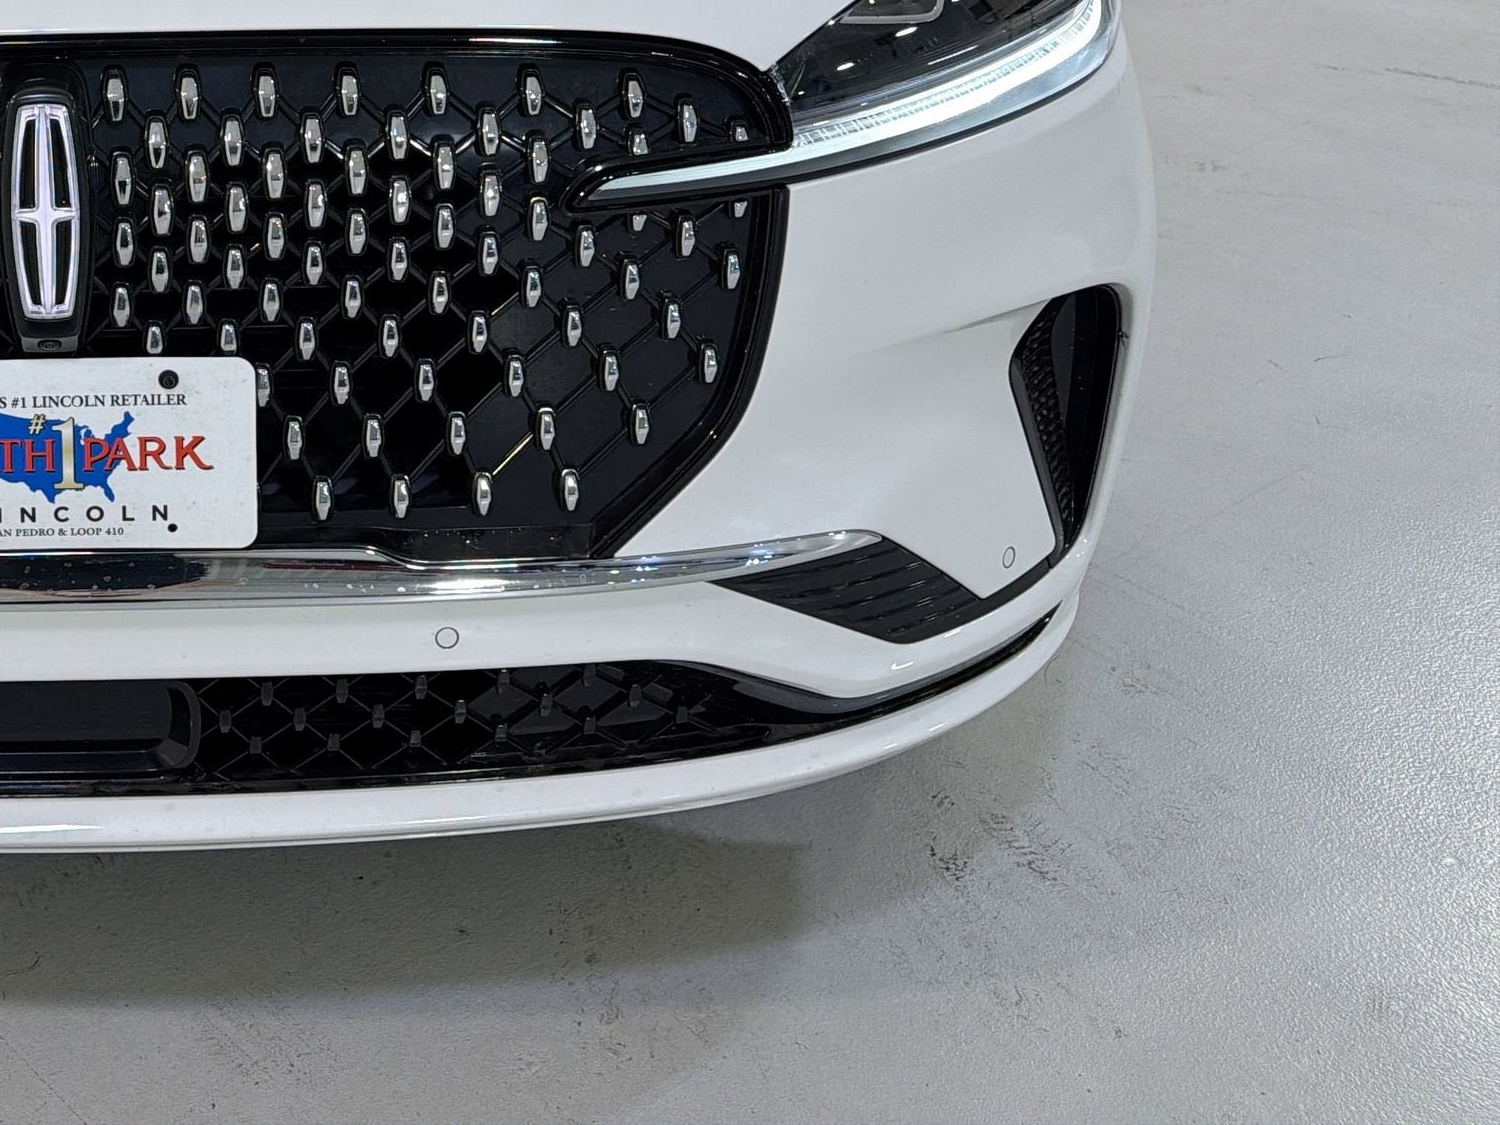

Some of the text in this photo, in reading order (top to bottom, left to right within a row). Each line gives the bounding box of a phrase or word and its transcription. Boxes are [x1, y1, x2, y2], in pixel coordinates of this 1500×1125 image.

[11, 396, 28, 409] #1
[32, 394, 106, 408] LINCOLN
[110, 393, 187, 407] RETAILER
[83, 435, 215, 473] PARK
[15, 527, 55, 538] PEDRO
[57, 528, 68, 537] &
[70, 527, 103, 537] LOOP
[105, 526, 125, 537] 410
